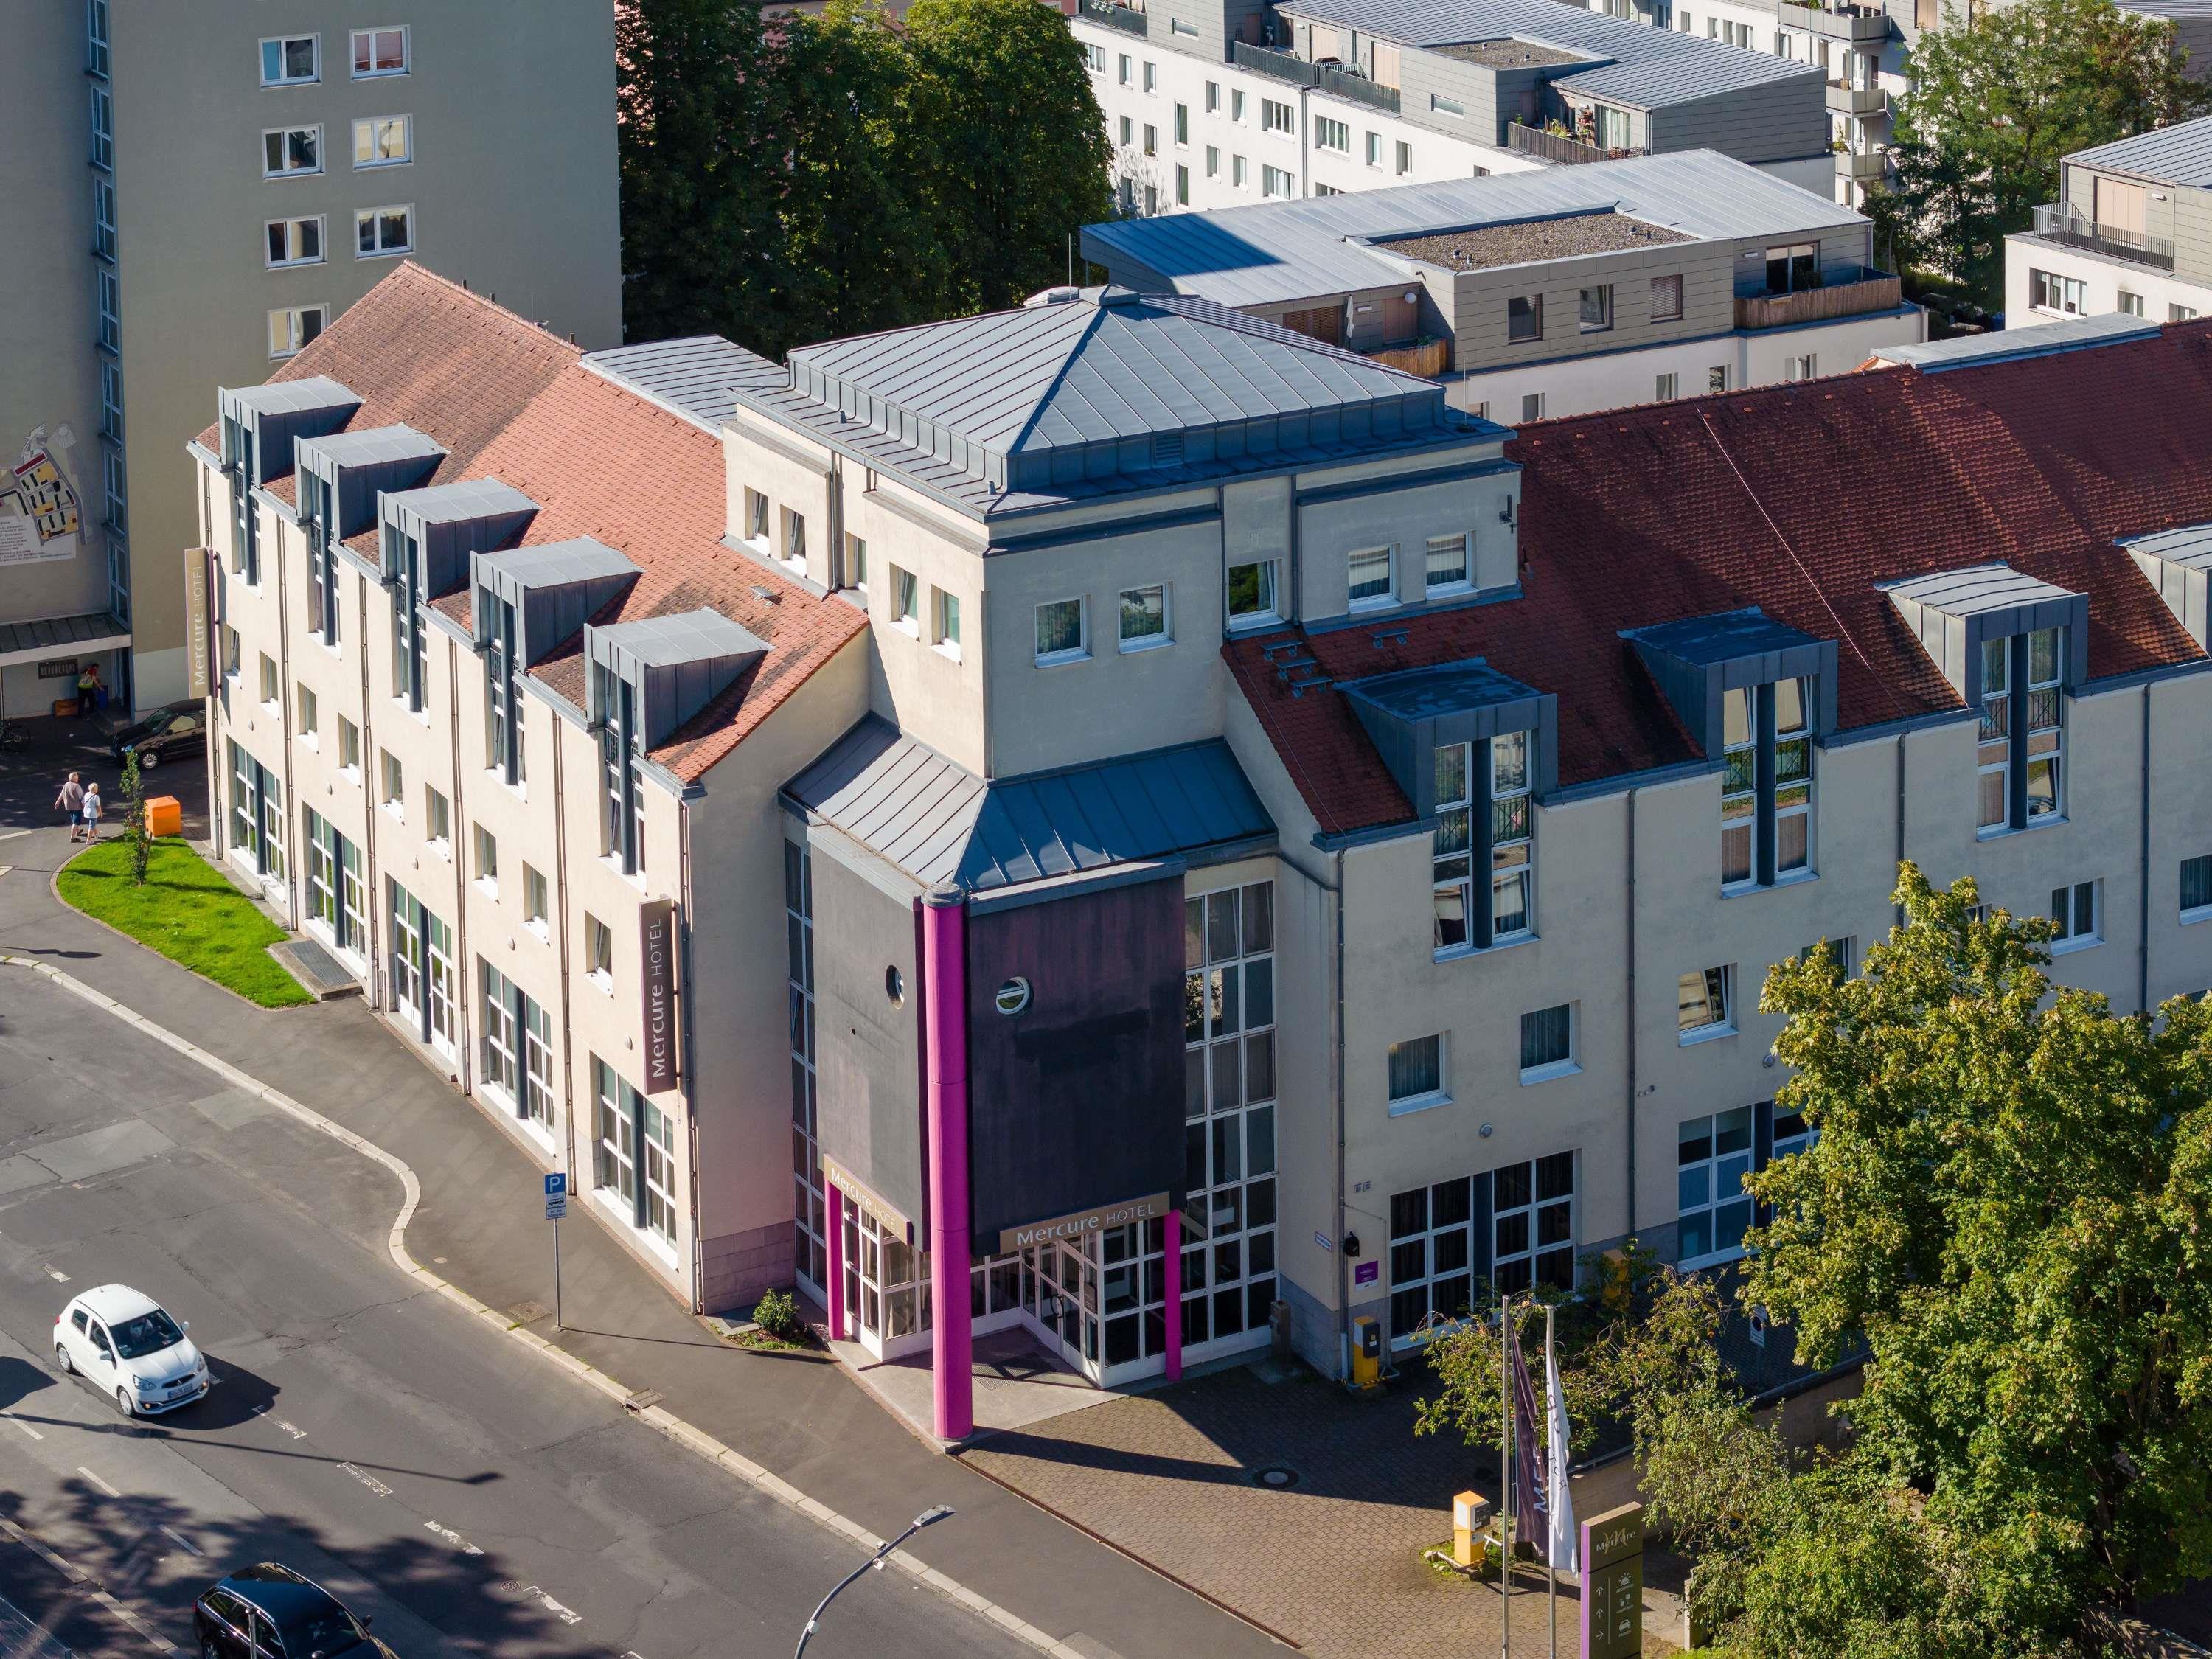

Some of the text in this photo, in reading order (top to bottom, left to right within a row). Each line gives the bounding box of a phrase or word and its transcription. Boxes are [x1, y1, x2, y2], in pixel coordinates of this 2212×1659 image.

[193, 563, 205, 686] Mercure HOTEL
[650, 918, 666, 1078] Mercure HOTEL
[549, 1176, 561, 1192] P
[832, 1167, 872, 1209] Mercure
[1018, 1203, 1155, 1246] Mercure HOTEL
[1596, 1531, 1636, 1552] Mrure
